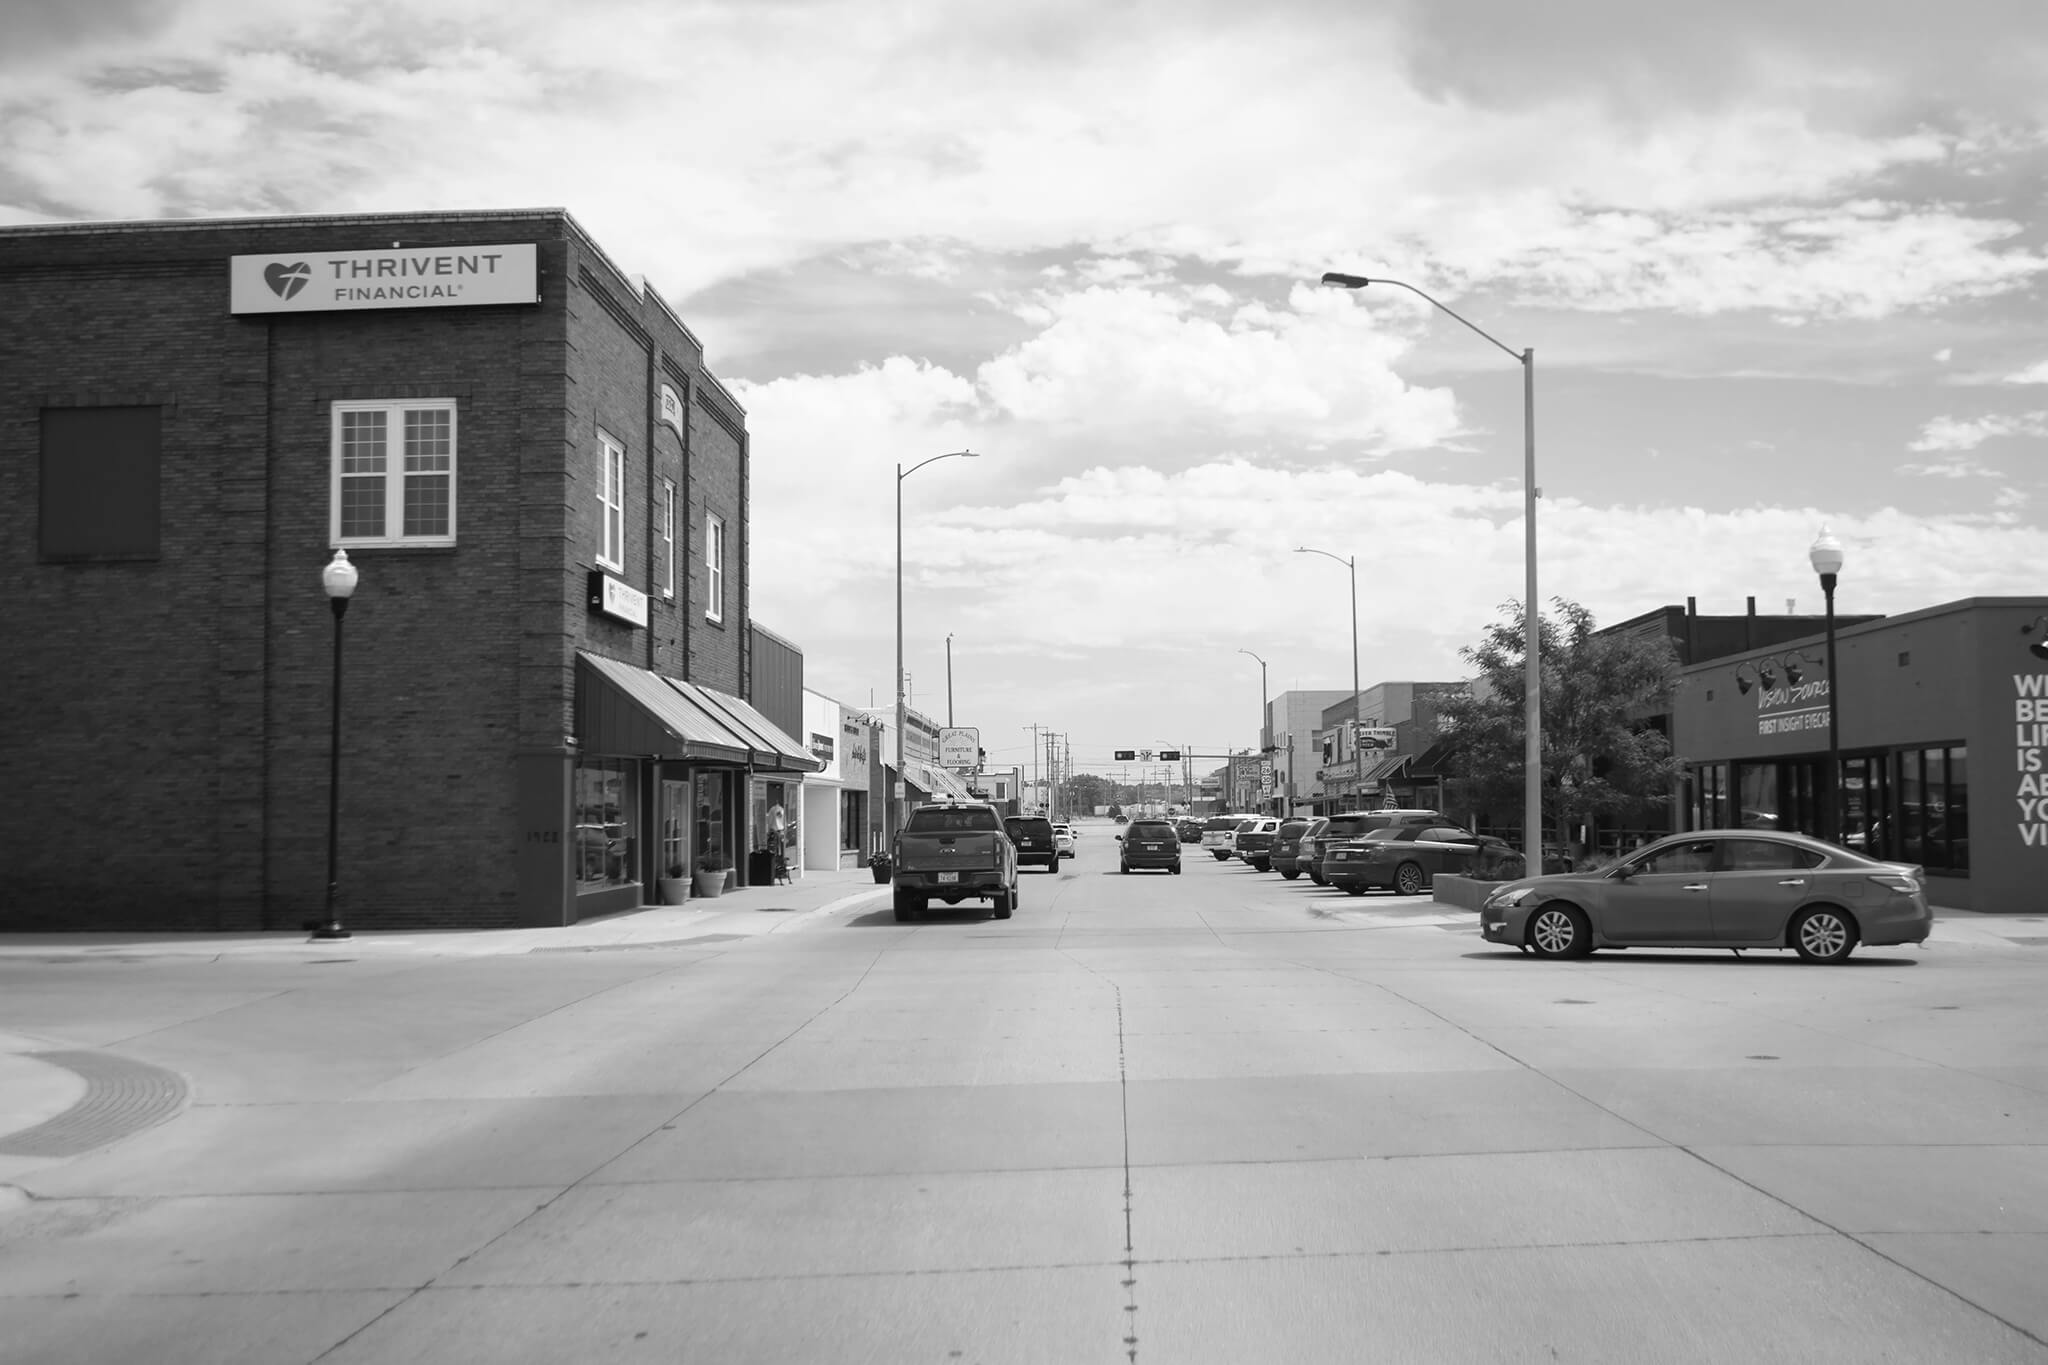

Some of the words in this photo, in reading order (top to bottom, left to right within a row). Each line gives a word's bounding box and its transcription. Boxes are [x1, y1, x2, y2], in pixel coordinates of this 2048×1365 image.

[328, 254, 503, 279] THRIVENT
[1758, 719, 1776, 735] FIRST
[1778, 715, 1804, 732] INSIGHT
[941, 731, 957, 743] GREAT
[958, 731, 976, 743] PLAINS
[2017, 748, 2042, 771] IS
